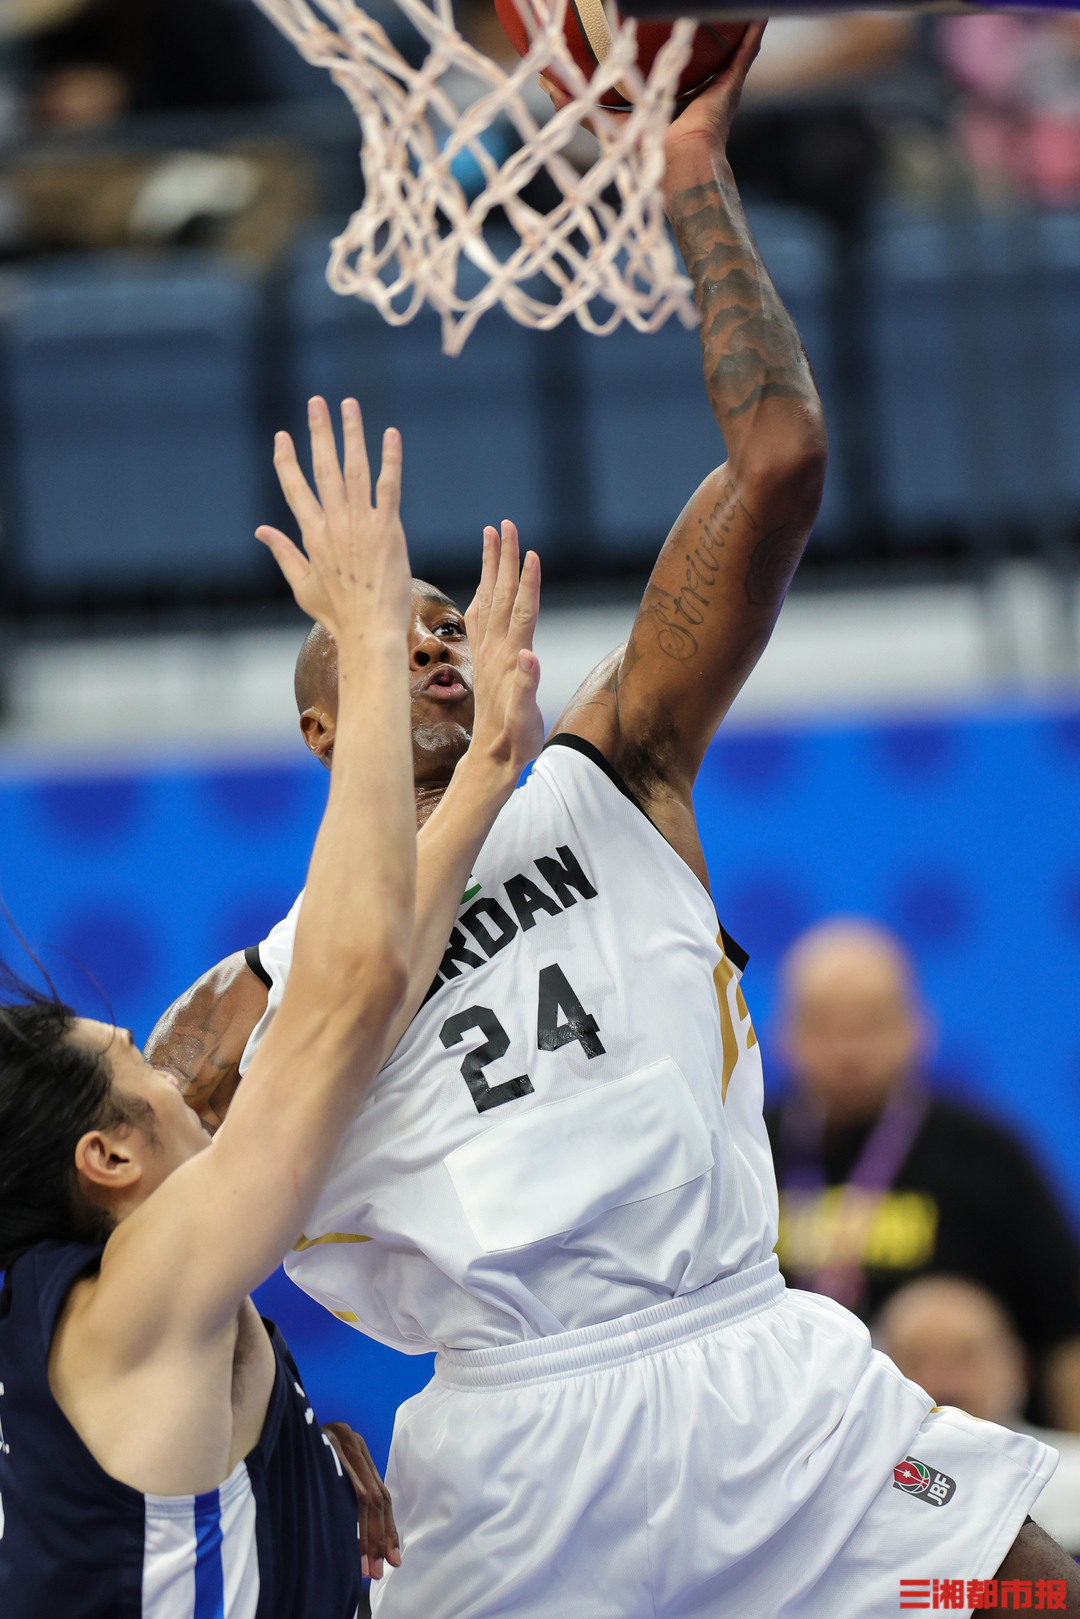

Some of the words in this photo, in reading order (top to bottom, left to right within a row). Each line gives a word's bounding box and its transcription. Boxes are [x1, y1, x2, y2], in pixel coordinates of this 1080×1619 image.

[416, 845, 598, 1010] RDAN
[438, 963, 606, 1114] 24
[927, 1473, 951, 1506] JBF
